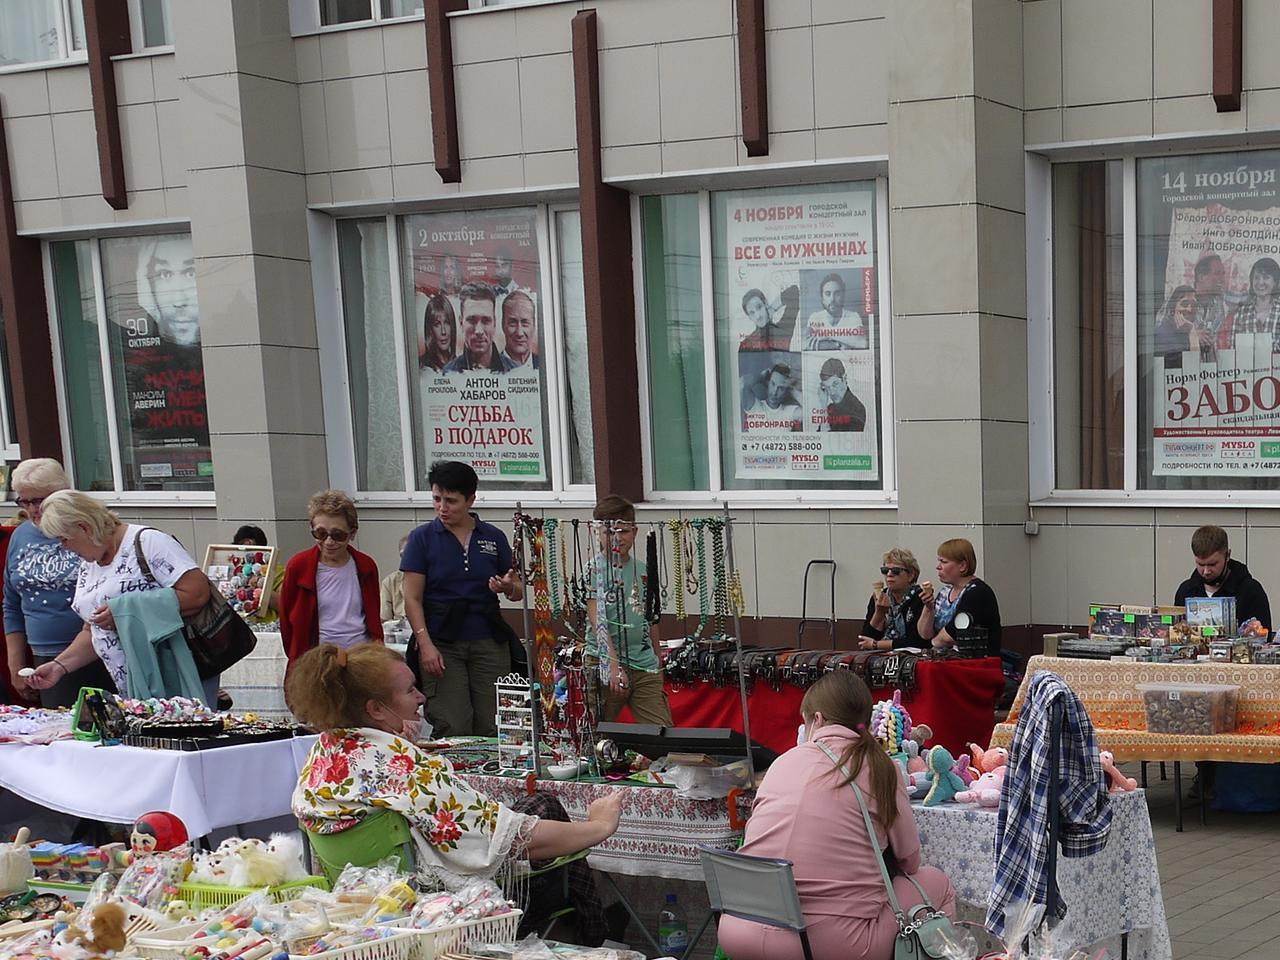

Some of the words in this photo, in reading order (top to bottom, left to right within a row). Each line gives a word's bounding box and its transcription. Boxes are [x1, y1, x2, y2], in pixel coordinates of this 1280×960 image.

[1161, 171, 1187, 193] 14
[1194, 165, 1276, 188] ноября
[1162, 192, 1204, 204] Городской
[1206, 190, 1259, 201] концертный
[808, 202, 848, 212] ГОРОДСКОЙ
[734, 209, 742, 222] 4
[746, 205, 804, 222] НОЯБРЯ
[808, 210, 852, 218] КОНЦЕРТНЫЙ
[1175, 213, 1207, 224] Федор
[419, 229, 428, 247] 2
[432, 226, 485, 246] октября
[1202, 228, 1226, 238] Инга
[1182, 240, 1205, 250] Иван
[734, 246, 761, 260] ВСЕ
[764, 245, 776, 259] О
[780, 241, 868, 258] МУЖЧИНАХ
[126, 318, 148, 336] 30
[128, 337, 160, 348] ОКТЯБРЯ
[508, 377, 538, 385] ЕВГЕНИЙ
[1166, 374, 1197, 386] Норм
[1199, 368, 1240, 381] Фостер
[466, 378, 498, 388] АНТОН
[460, 390, 506, 400] ХАБАРОВ
[134, 400, 166, 409] АВЕРИН
[448, 405, 515, 427] СУДЬБА
[1222, 412, 1280, 424] скандальная
[434, 428, 444, 444] В
[448, 428, 534, 449] ПОДАРОК
[1221, 441, 1255, 449] MYSLO
[792, 454, 818, 462] MYSLO
[472, 460, 496, 468] MYSLO
[1162, 462, 1211, 470] ПОДРОБНОСТИ
